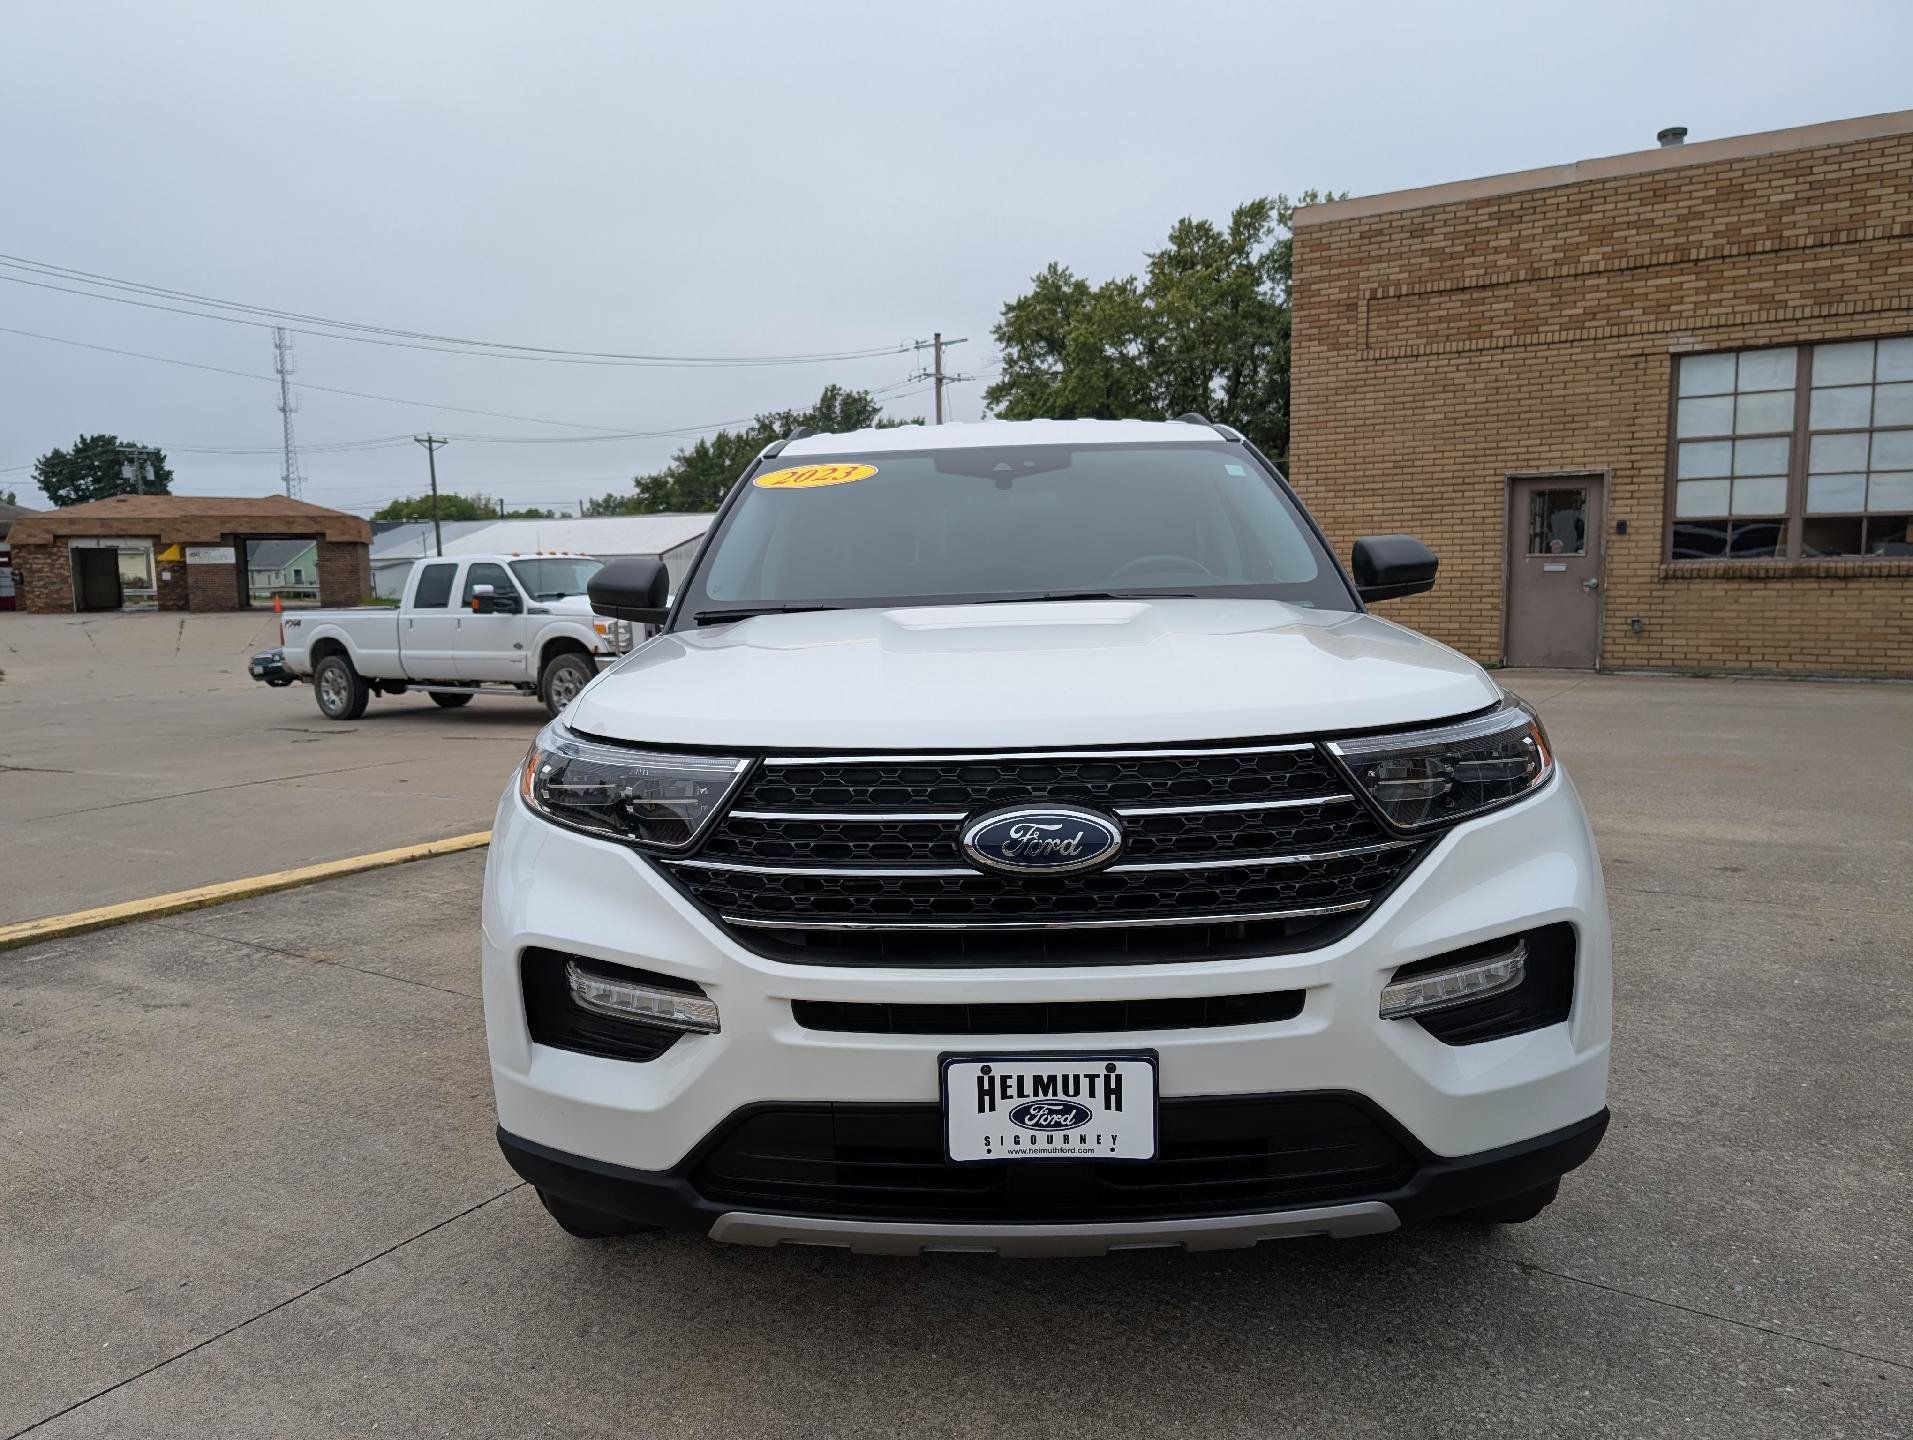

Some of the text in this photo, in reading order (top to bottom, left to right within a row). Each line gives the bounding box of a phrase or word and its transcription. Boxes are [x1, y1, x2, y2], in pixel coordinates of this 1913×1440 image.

[771, 466, 858, 485] 2023
[1001, 823, 1084, 857] Ford
[976, 1073, 1123, 1114] HELMUTH
[1024, 1104, 1076, 1126] Ford
[983, 1134, 1118, 1147] SIGOURNEY
[1007, 1146, 1095, 1155] www.helmuthford.com
